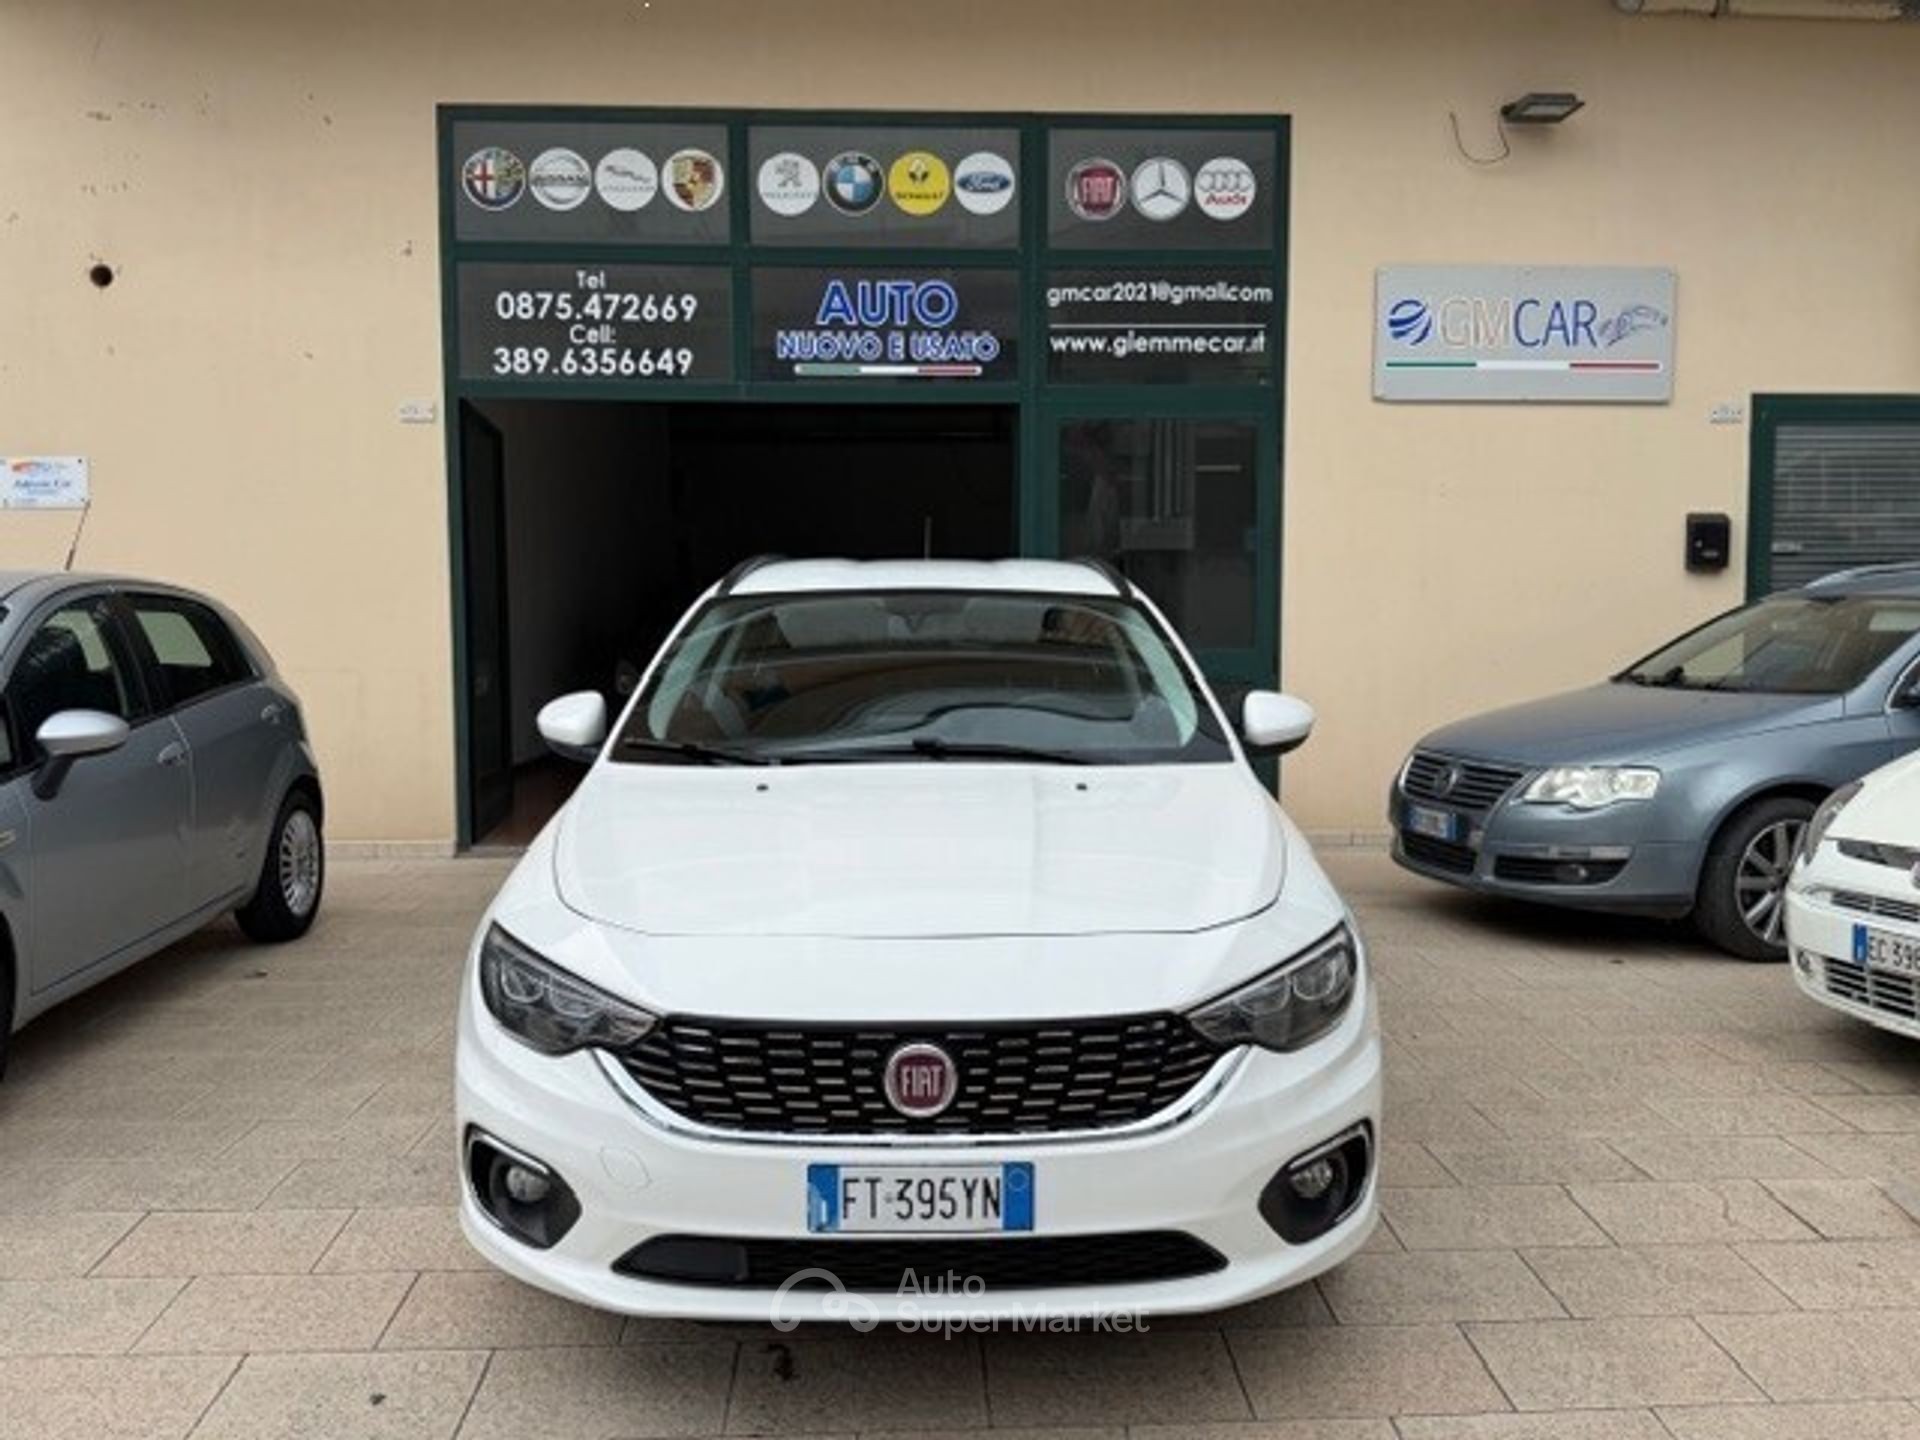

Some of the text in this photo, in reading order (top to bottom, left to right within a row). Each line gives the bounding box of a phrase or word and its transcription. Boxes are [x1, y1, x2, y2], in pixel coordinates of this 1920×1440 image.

[1205, 192, 1248, 206] Audi
[576, 270, 606, 289] Tel
[496, 291, 698, 322] 0875.472669
[815, 279, 958, 327] AUTO
[569, 323, 617, 344] Cell:
[776, 330, 1000, 362] NUOVO E USATO
[1050, 330, 1265, 358] www.giemmecar.it
[494, 347, 693, 375] 389.6356649
[901, 1065, 943, 1097] FIAT
